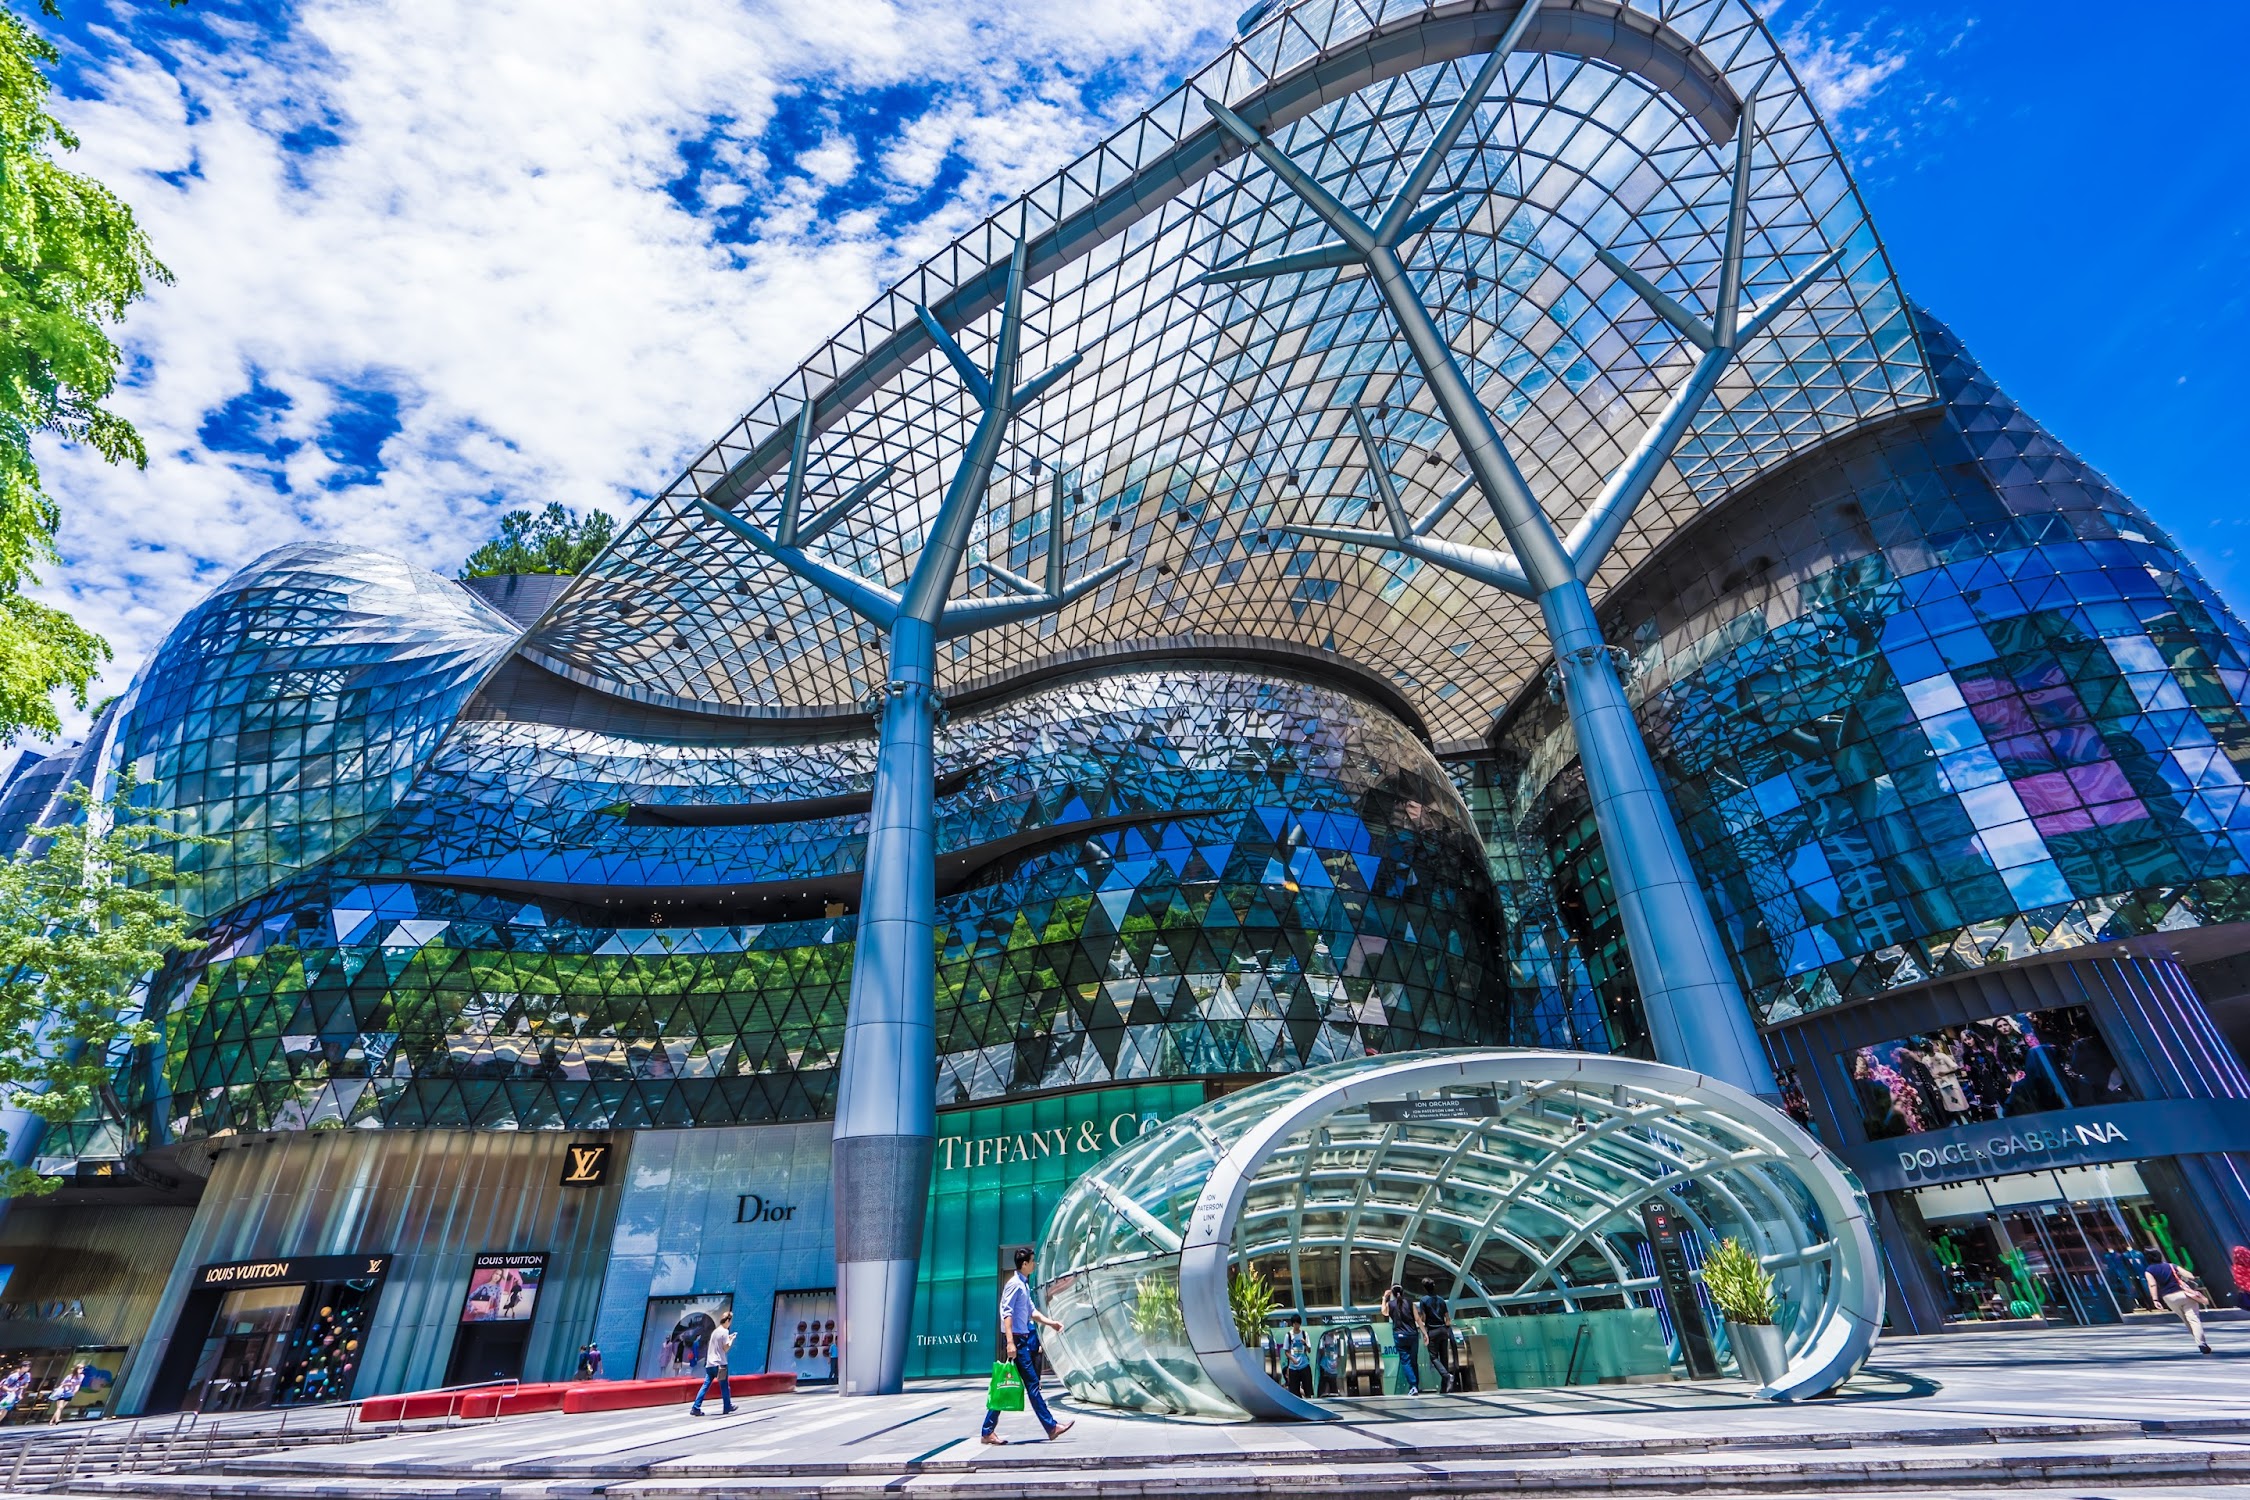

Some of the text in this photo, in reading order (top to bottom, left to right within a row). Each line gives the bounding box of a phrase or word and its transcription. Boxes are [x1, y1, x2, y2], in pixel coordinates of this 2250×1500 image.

[938, 1126, 1073, 1170] TIFFANY
[1076, 1119, 1104, 1153] &
[1898, 1121, 2129, 1171] DOLCE & GABBANA
[732, 1194, 797, 1223] Dior
[1197, 1202, 1224, 1211] PATERSON
[1203, 1213, 1216, 1222] LINK
[477, 1255, 543, 1265] LOUIS VUITTON
[205, 1263, 289, 1283] LOUIS VUITTON
[0, 1299, 85, 1320] RADA
